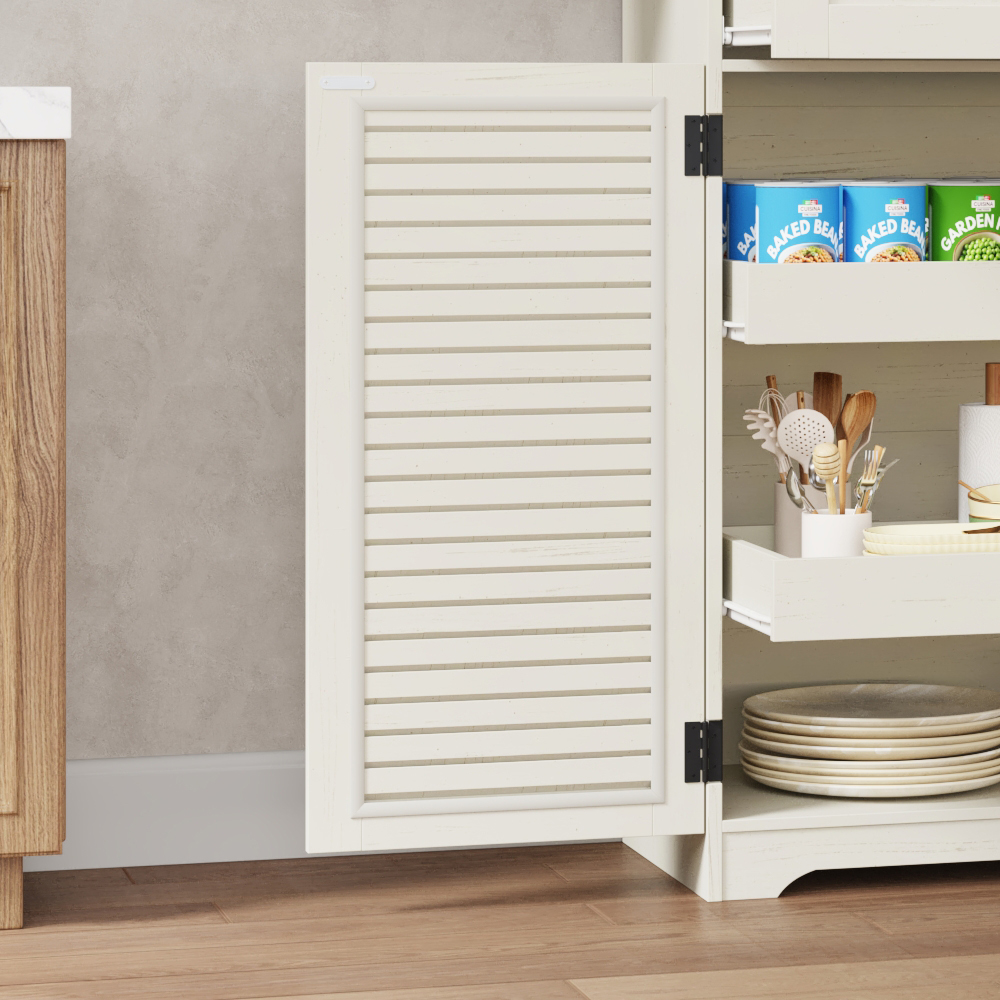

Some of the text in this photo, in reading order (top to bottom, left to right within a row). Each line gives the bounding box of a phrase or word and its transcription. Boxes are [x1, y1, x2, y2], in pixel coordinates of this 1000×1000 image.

[766, 218, 838, 260] BAKED BEAN
[853, 217, 926, 259] BAKED BEAN
[941, 213, 995, 252] GARDEN
